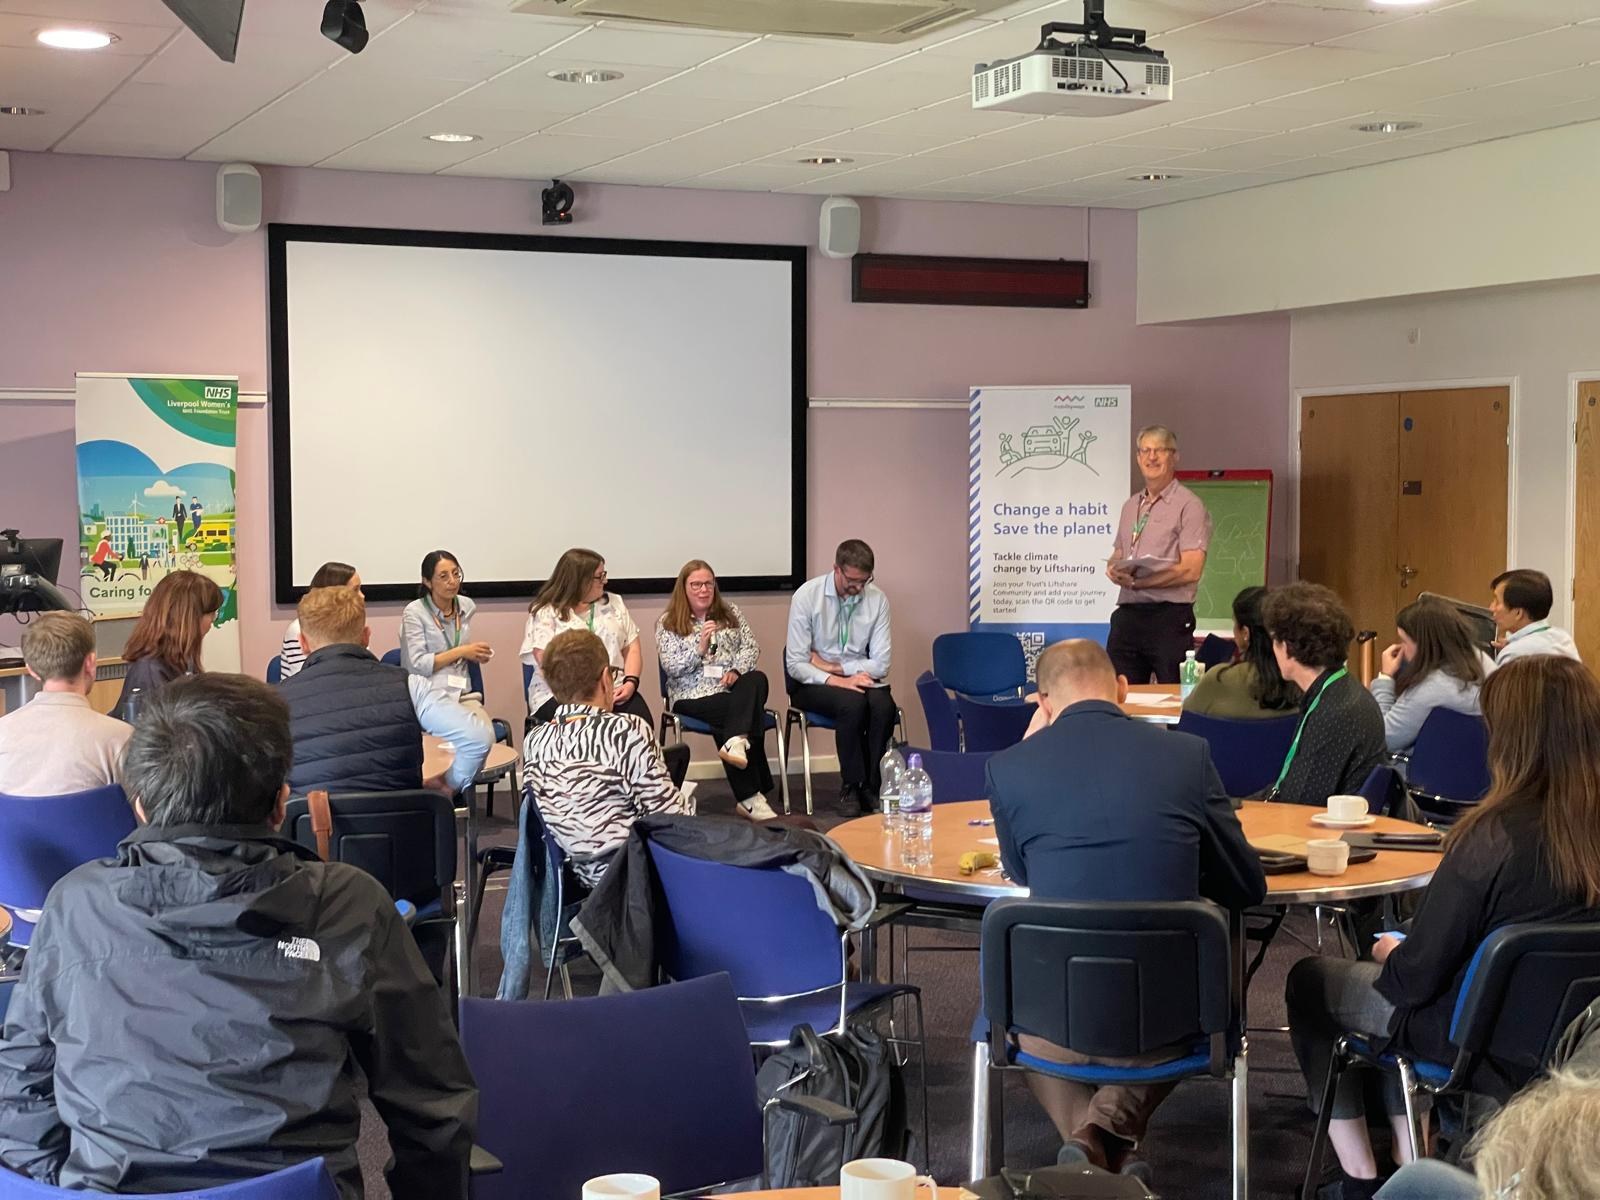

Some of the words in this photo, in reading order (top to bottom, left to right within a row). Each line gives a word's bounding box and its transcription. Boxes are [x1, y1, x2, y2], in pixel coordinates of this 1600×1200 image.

[206, 387, 231, 398] NHS
[167, 400, 199, 408] Liverpool
[1095, 397, 1118, 407] NHS
[993, 502, 1050, 518] Change
[1055, 505, 1063, 515] a
[1069, 502, 1108, 515] habit
[993, 522, 1028, 535] Save
[1034, 522, 1058, 535] the
[1063, 522, 1112, 537] planet
[993, 552, 1021, 561] Tackle
[1024, 552, 1058, 561] climate
[993, 564, 1027, 574] change
[1030, 564, 1042, 574] by
[1044, 564, 1096, 574] Liftsharing
[90, 585, 135, 599] Caring
[138, 585, 152, 596] fo
[993, 589, 1032, 597] Community
[291, 936, 307, 945] THE
